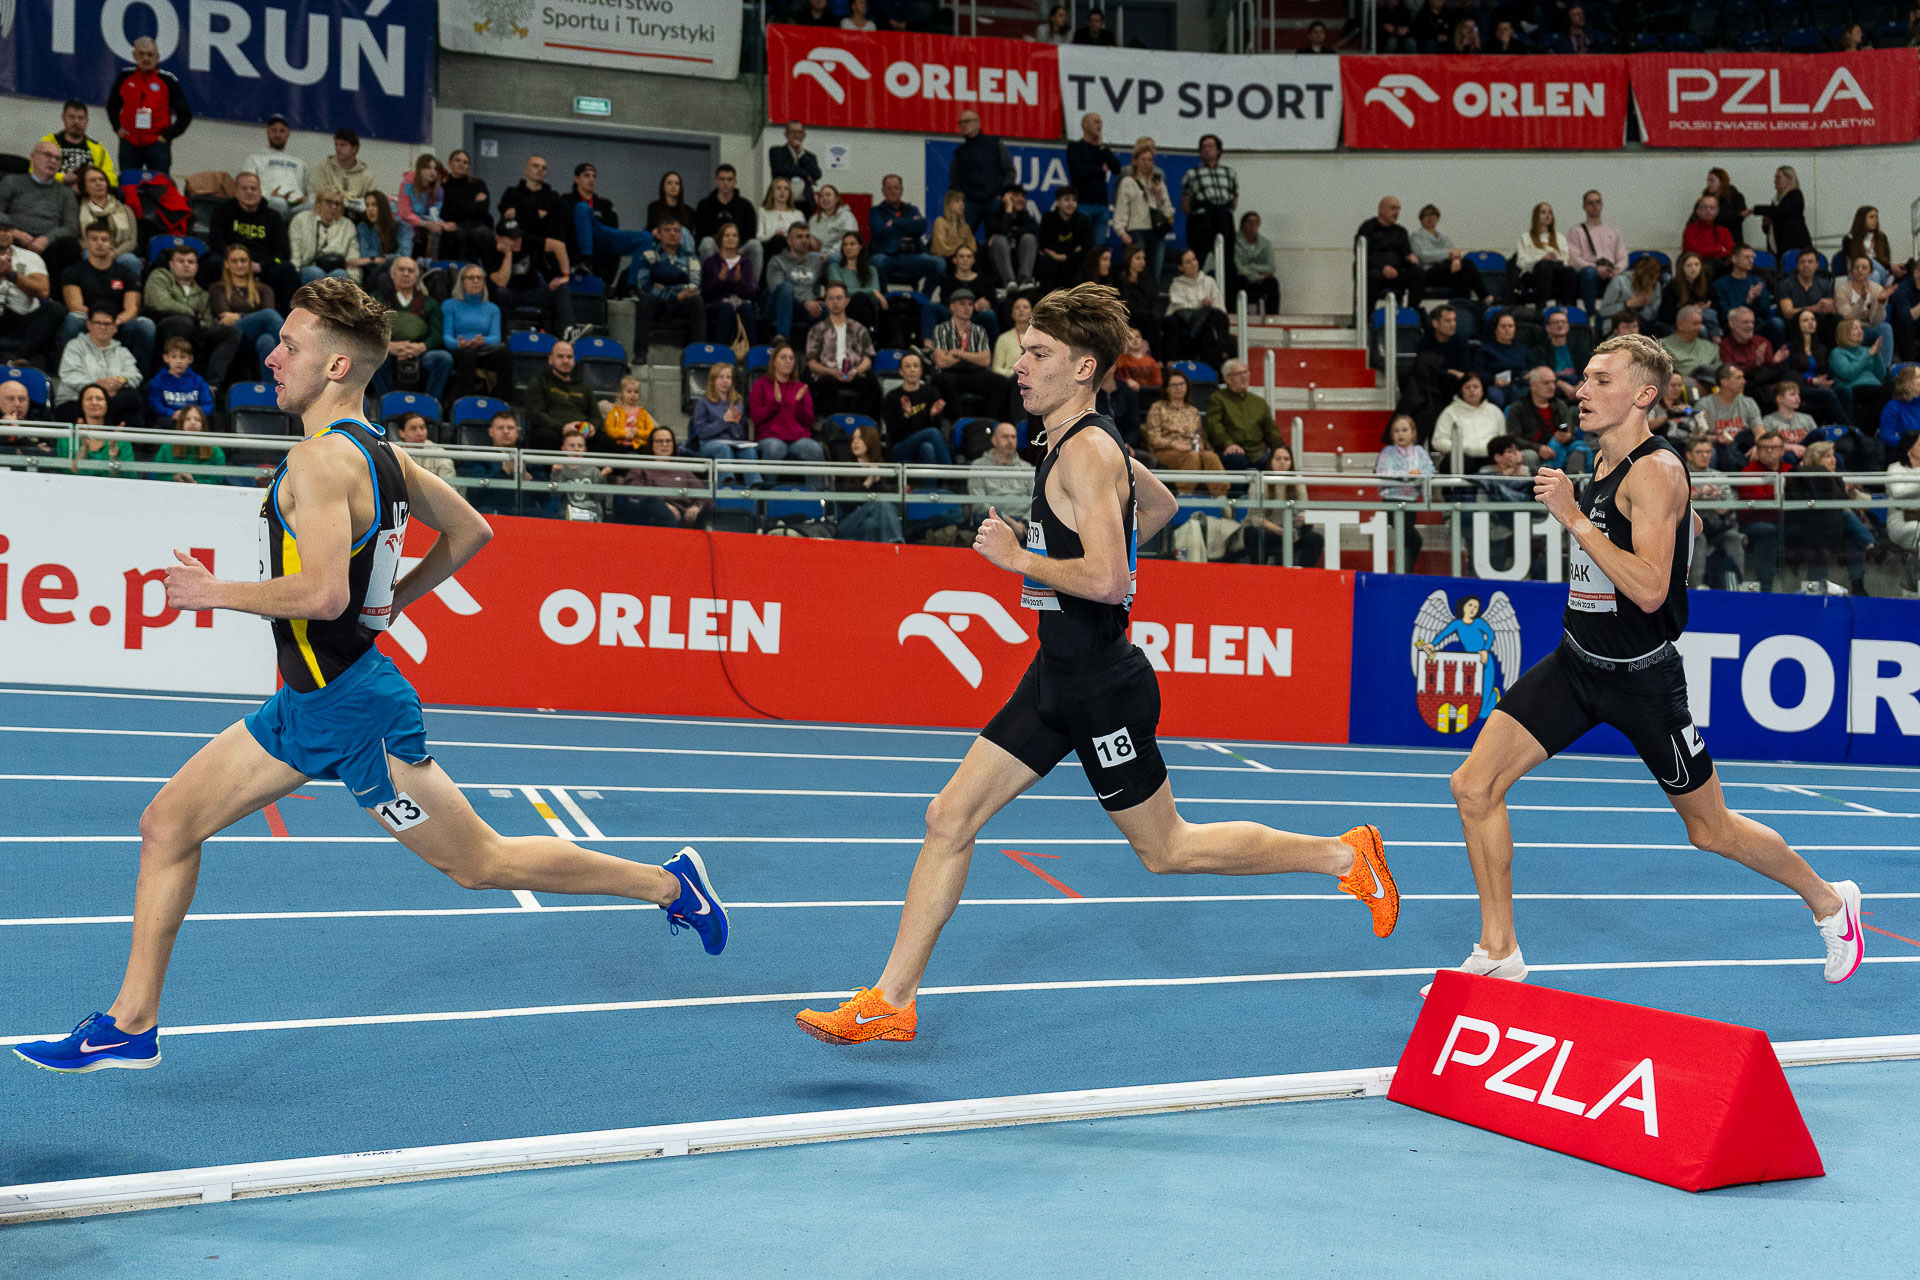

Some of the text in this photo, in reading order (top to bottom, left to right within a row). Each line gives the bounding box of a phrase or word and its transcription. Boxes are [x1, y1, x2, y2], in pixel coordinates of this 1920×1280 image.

[543, 7, 715, 43] Sportu i Turystyki
[884, 61, 1038, 106] ORLEN
[1068, 74, 1333, 119] TVP SPORT
[1453, 81, 1605, 117] ORLEN
[1668, 66, 1874, 113] PZLA
[1669, 120, 1712, 130] POLSKI
[1820, 117, 1875, 129] ATLETYKI
[1305, 511, 1388, 574] T1
[1473, 511, 1562, 583] U1
[539, 588, 781, 654] ORLEN
[1131, 621, 1293, 677] RLEN
[1628, 648, 1665, 672] NIKE
[1674, 631, 1920, 736] TOR
[1097, 735, 1132, 762] 18
[381, 799, 421, 826] 13
[1432, 1015, 1660, 1138] PZLA
